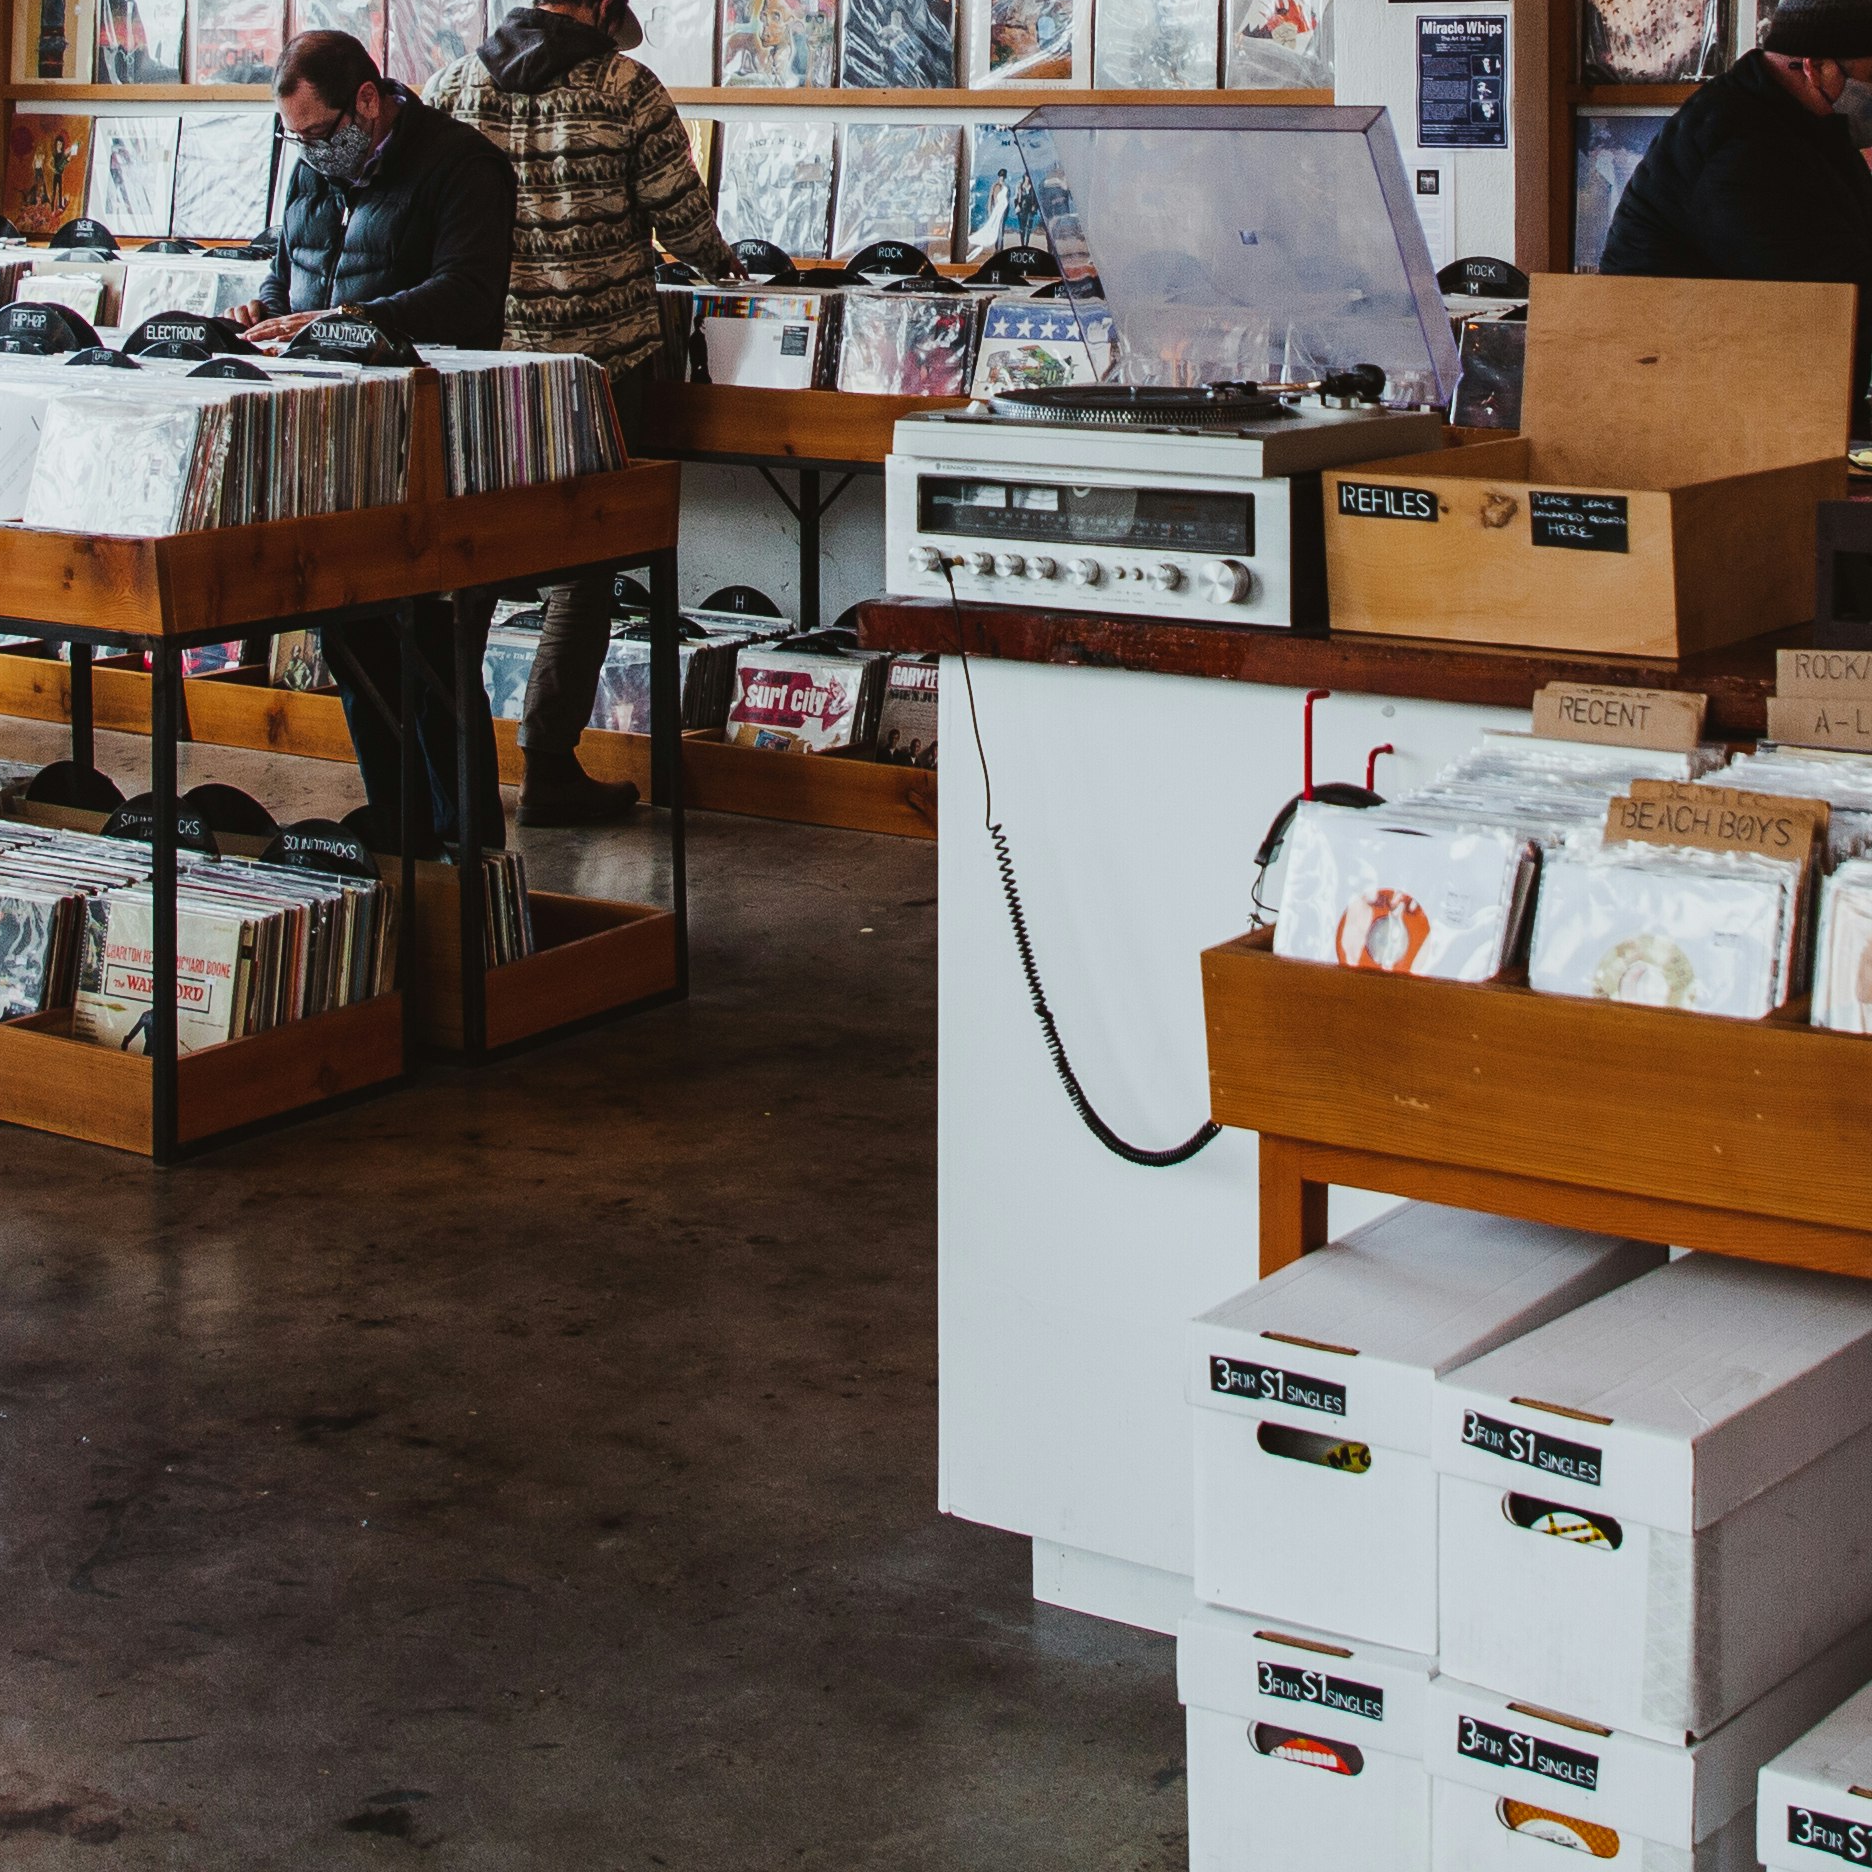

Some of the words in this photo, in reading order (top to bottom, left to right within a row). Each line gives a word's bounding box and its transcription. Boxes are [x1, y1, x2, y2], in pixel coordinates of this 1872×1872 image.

[1422, 21, 1464, 35] Miracle
[1466, 20, 1503, 37] Whips
[76, 218, 93, 230] NEW
[878, 245, 903, 258] ROCK
[1010, 251, 1035, 264] ROCK
[146, 324, 206, 341] ELECTRONIC
[942, 463, 978, 473] KENWOOD
[1341, 485, 1430, 517] REFILES
[1533, 494, 1573, 507] PLEASE
[1582, 499, 1617, 510] LEAVE
[1532, 509, 1584, 522] UNWANTED
[1547, 523, 1595, 538] HERE
[613, 580, 623, 598] G
[732, 591, 745, 610] H
[891, 665, 924, 688] GARY
[744, 683, 788, 711] surf
[790, 682, 829, 718] city
[1558, 695, 1651, 729] RECENT
[1814, 709, 1870, 735] A-L
[1621, 799, 1711, 834] BEACH
[1717, 811, 1793, 847] BOYS
[106, 944, 142, 962] CHARLTON
[206, 960, 232, 979] BOONE
[113, 979, 125, 989] The
[1286, 1385, 1343, 1413] SINGLES
[1538, 1450, 1599, 1482] SINGLES
[1327, 1689, 1382, 1719] SINGLES
[1538, 1756, 1596, 1787] SINGLES
